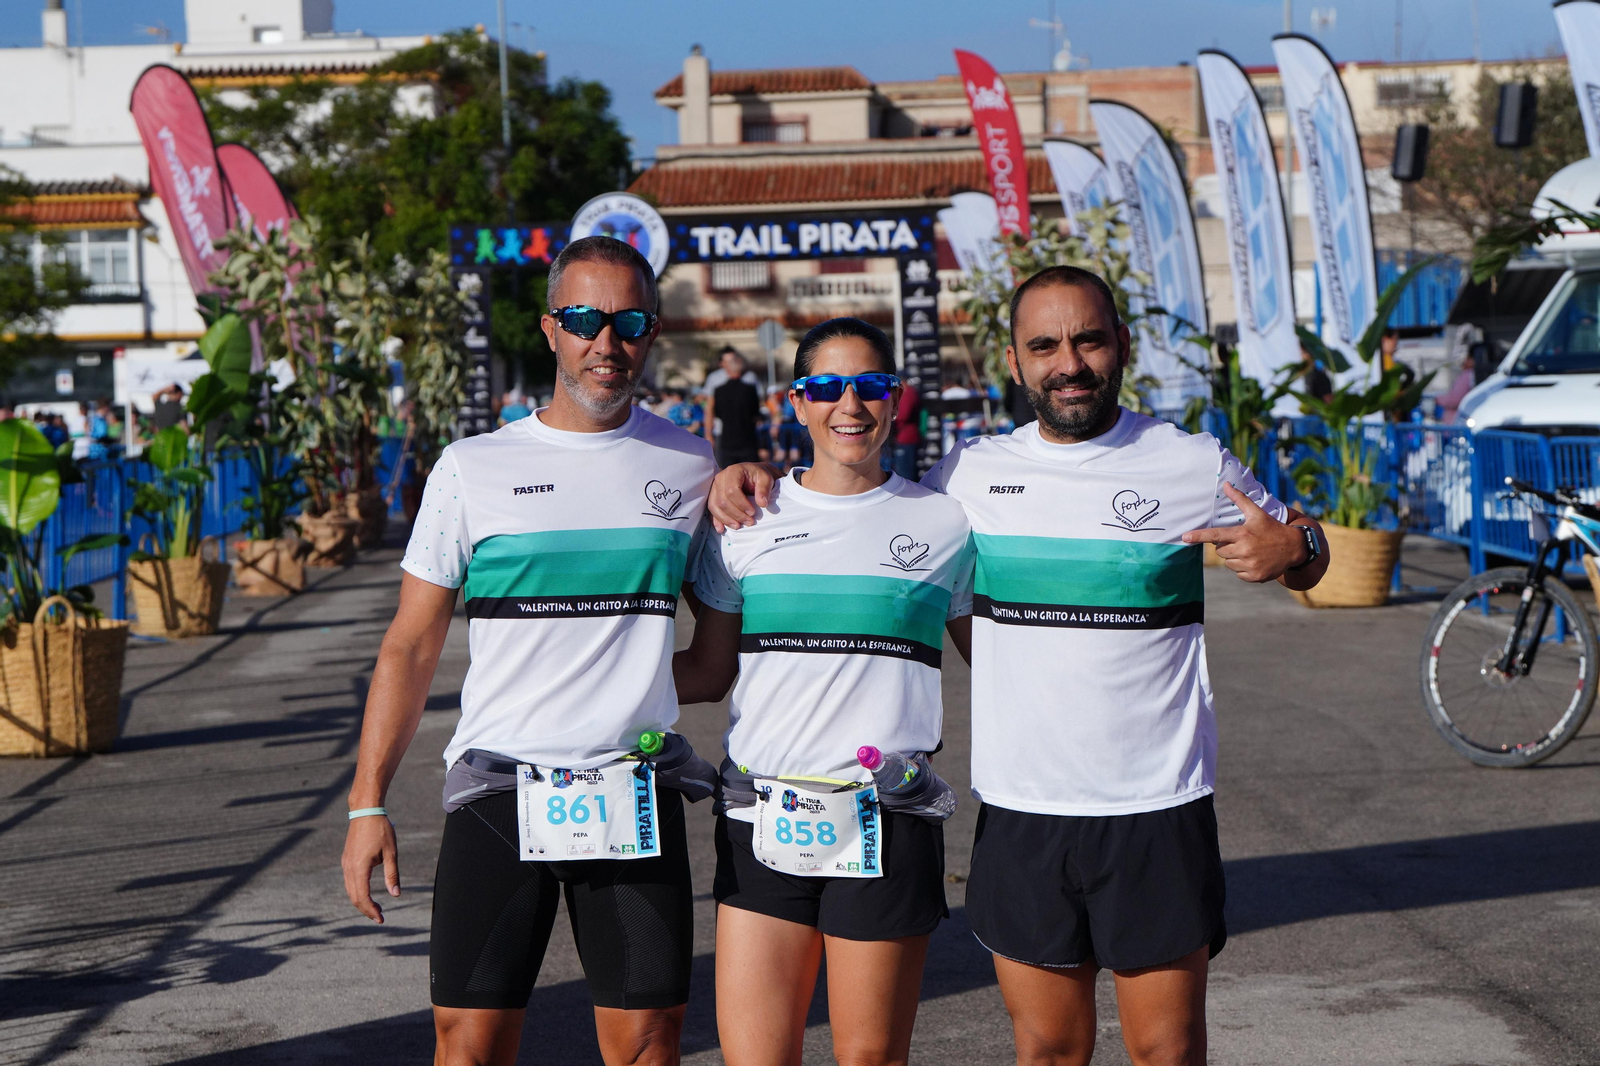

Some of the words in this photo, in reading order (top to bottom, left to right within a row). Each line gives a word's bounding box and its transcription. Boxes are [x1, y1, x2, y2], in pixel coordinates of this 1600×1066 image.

[690, 224, 792, 257] TRAIL
[798, 218, 919, 253] PIRATA
[513, 484, 555, 496] FASTER
[989, 485, 1026, 494] FASTER
[774, 532, 810, 543] FASTER
[577, 601, 591, 611] UN
[593, 601, 622, 610] GRITO
[623, 600, 630, 609] A
[630, 599, 638, 608] LA
[1024, 610, 1038, 619] UN
[1039, 611, 1068, 621] GRITO
[1069, 612, 1077, 621] A
[1079, 612, 1091, 622] LA
[806, 639, 819, 647] UN
[821, 639, 848, 648] GRITO
[848, 640, 855, 648] A
[857, 640, 867, 649] LA
[572, 773, 604, 782] PIRATA
[760, 785, 773, 793] 10
[547, 794, 607, 825] 861
[797, 801, 827, 811] PIRATA
[775, 817, 838, 846] 858
